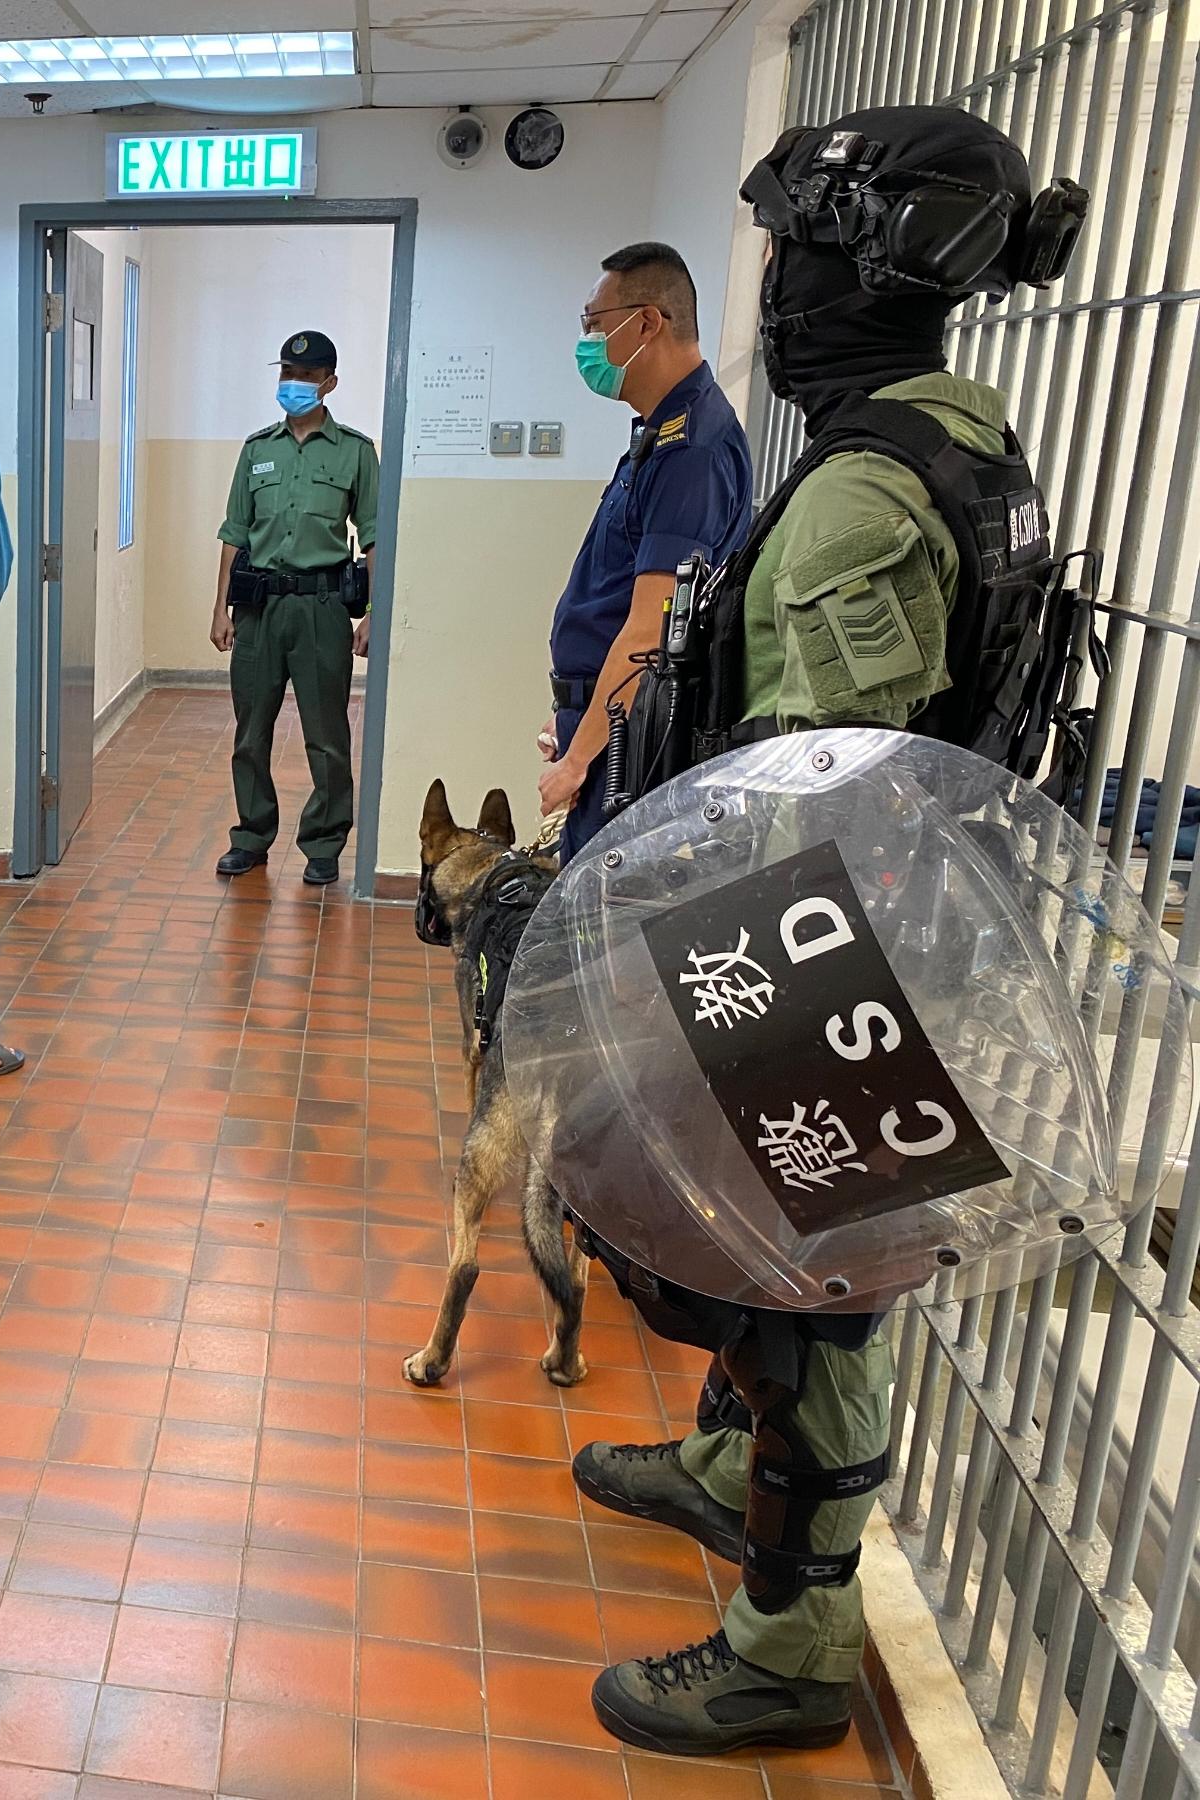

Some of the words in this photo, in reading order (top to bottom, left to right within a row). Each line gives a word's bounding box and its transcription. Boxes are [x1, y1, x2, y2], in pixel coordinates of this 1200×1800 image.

[123, 140, 214, 190] EXIT
[224, 138, 297, 187] 出口
[1018, 502, 1033, 547] CSD
